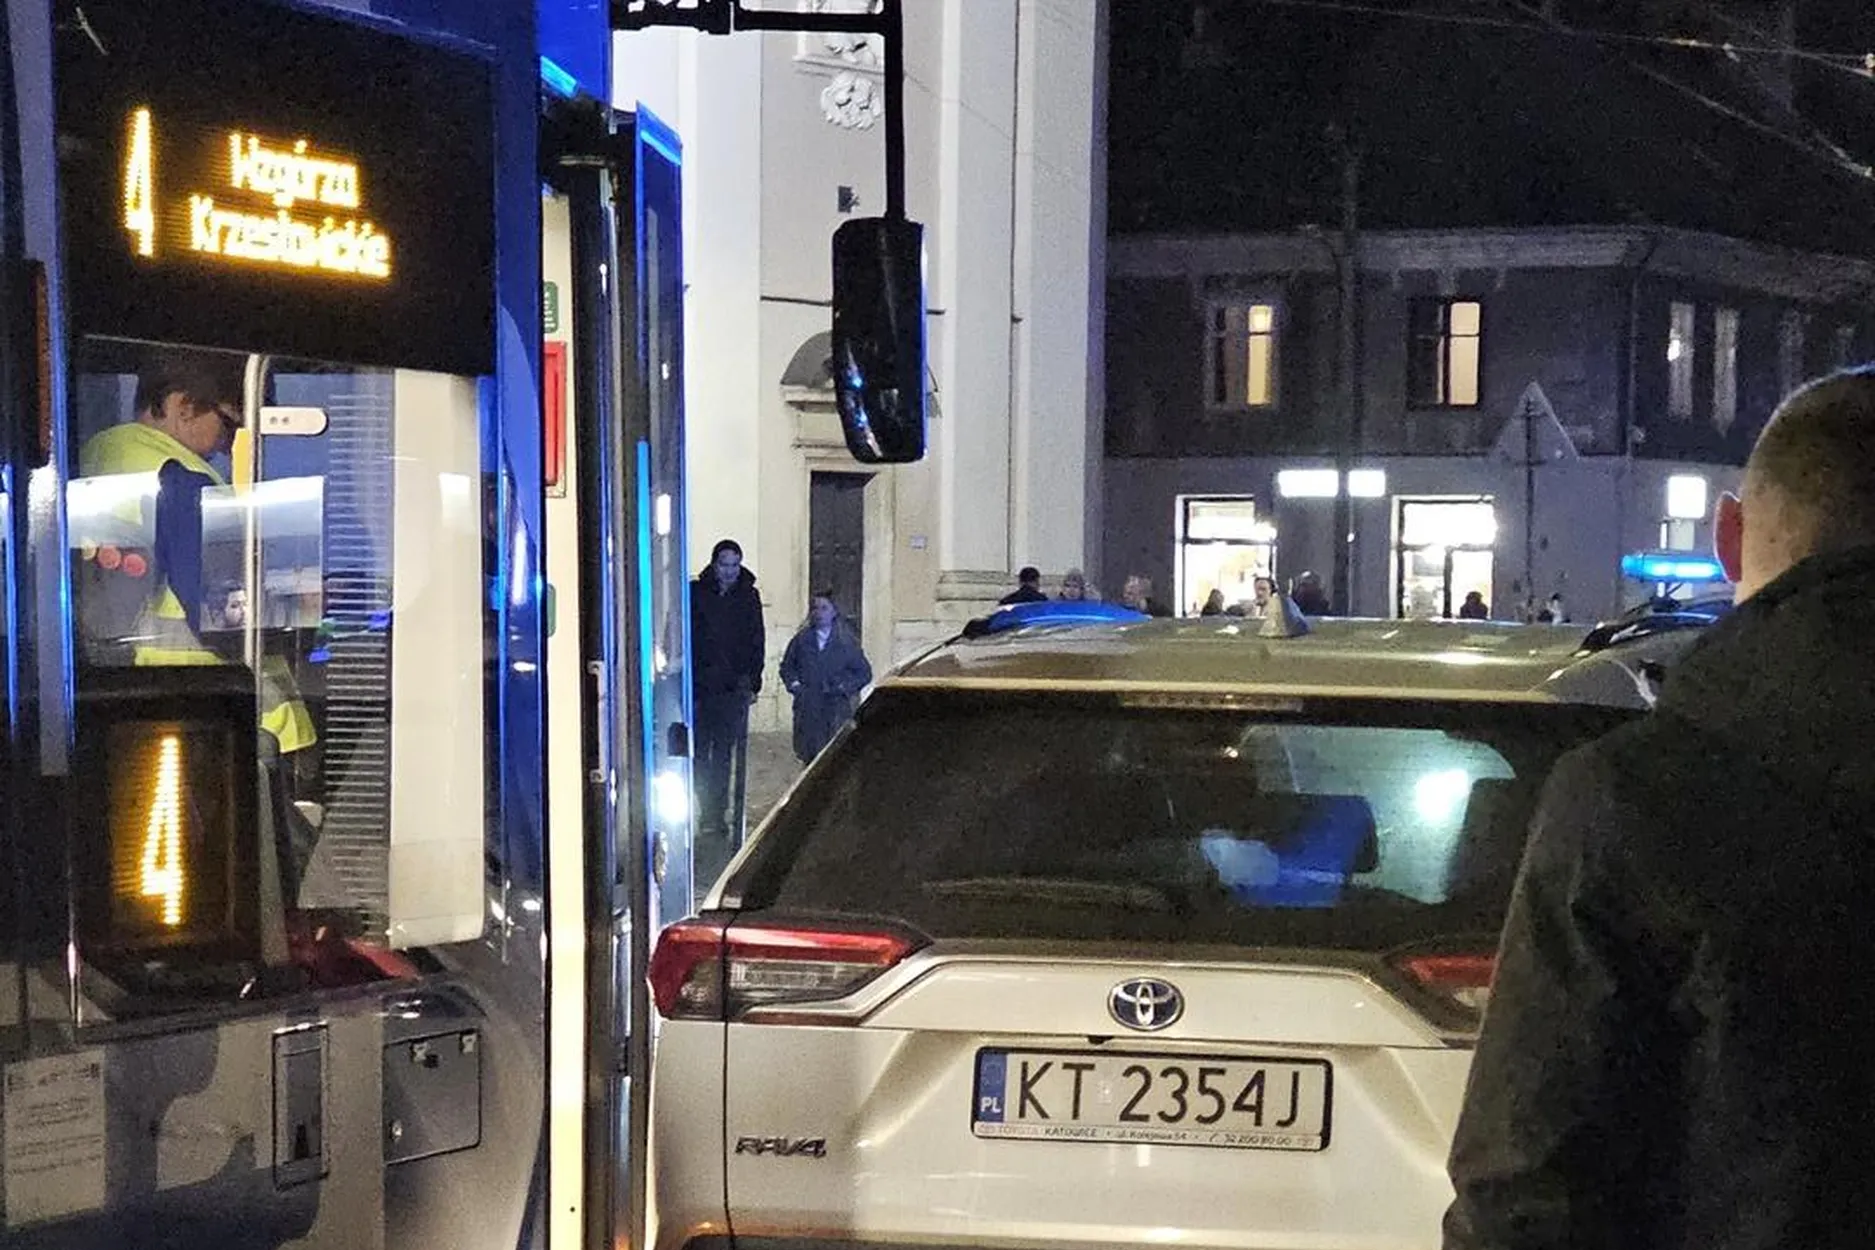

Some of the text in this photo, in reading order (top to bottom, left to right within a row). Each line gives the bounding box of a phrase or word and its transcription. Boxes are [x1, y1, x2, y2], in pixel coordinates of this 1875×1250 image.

[124, 107, 154, 257] 4
[140, 736, 183, 926] 4
[981, 1096, 1001, 1113] PL
[1018, 1060, 1300, 1128] KT 2354J
[735, 1137, 827, 1159] RAV4
[1044, 1125, 1097, 1137] KATOWICE
